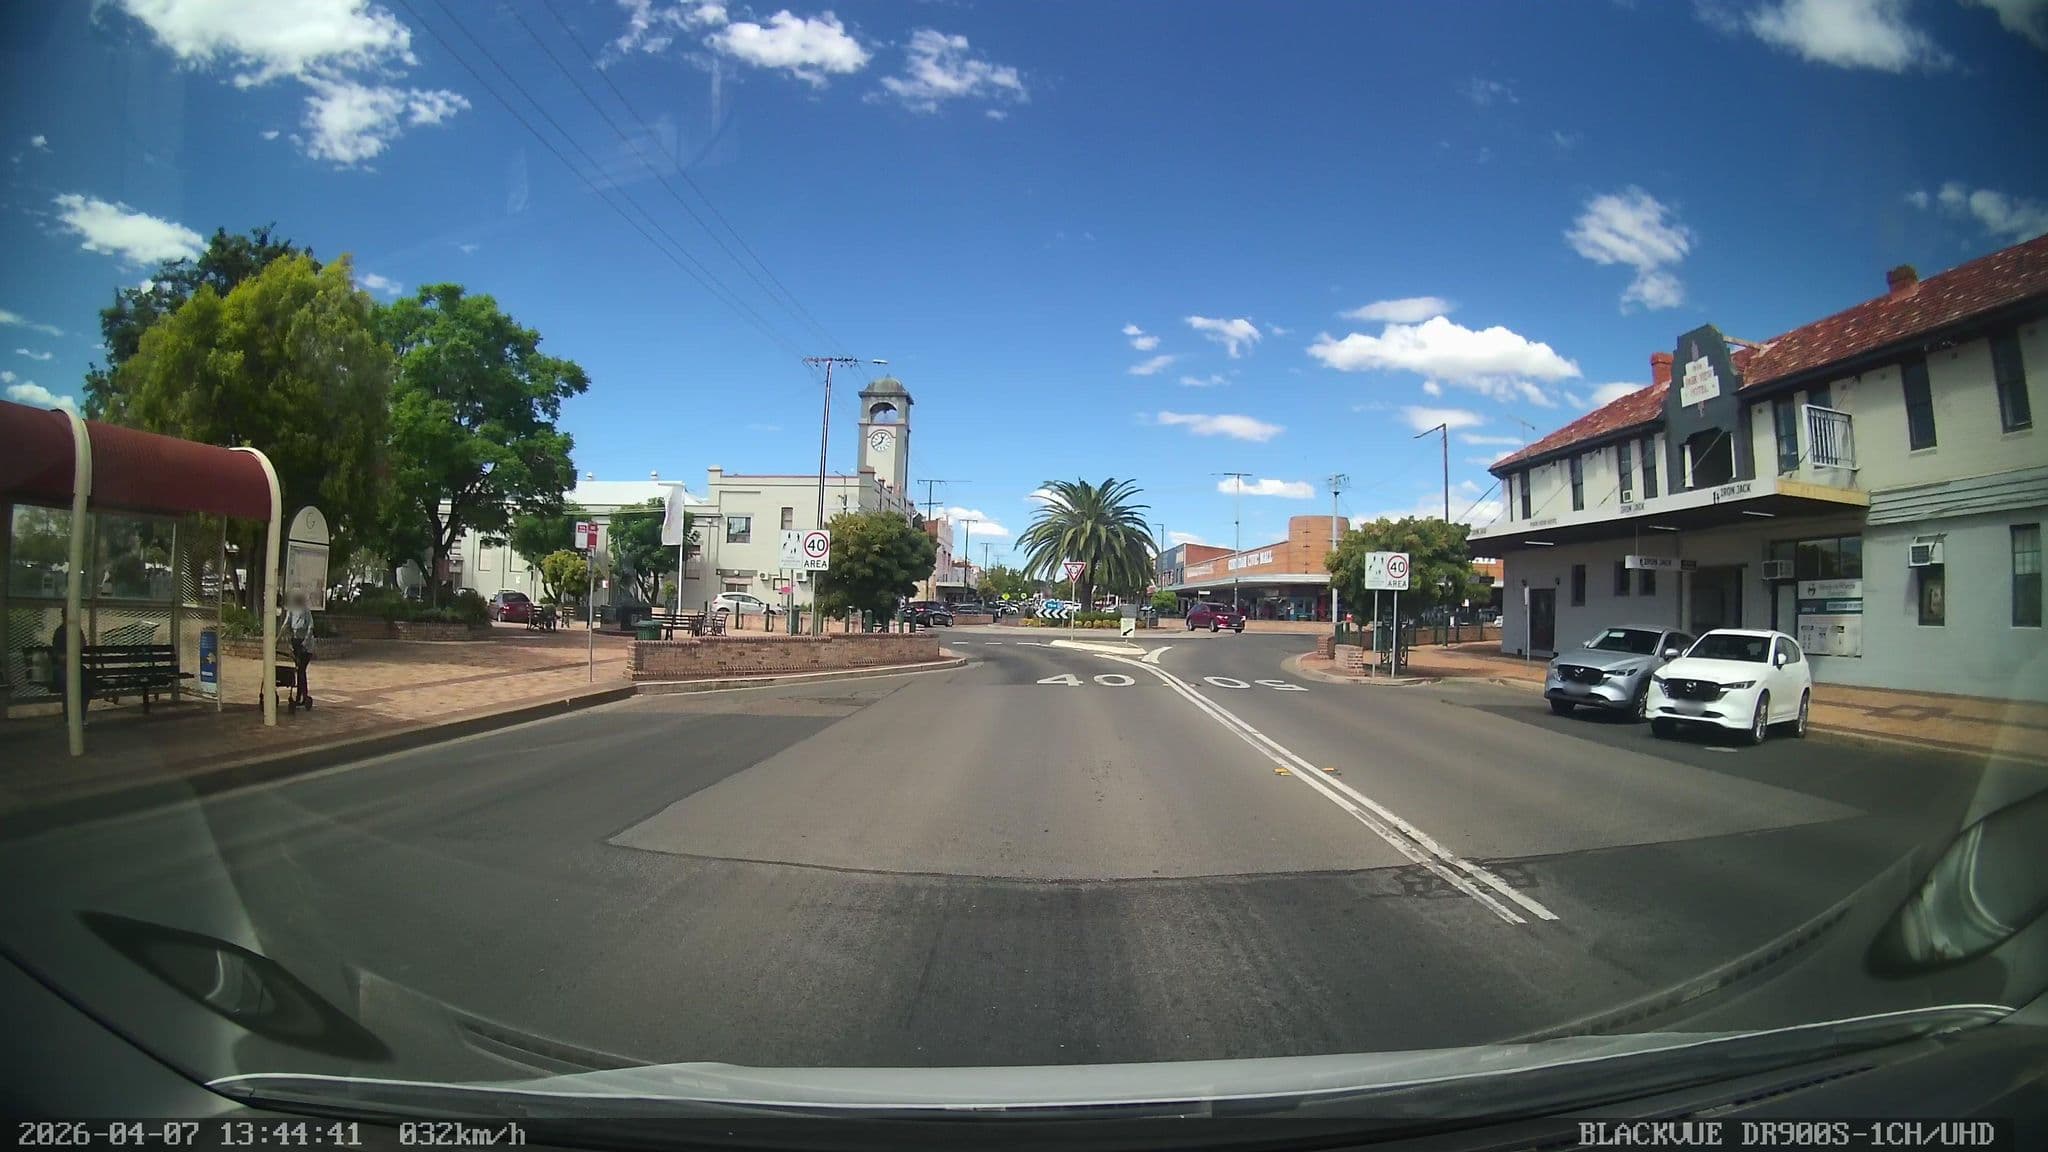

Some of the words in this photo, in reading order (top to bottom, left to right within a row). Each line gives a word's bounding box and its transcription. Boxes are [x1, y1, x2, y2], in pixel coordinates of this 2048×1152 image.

[1720, 487, 1736, 498] IRON
[1736, 484, 1752, 495] JACK
[808, 539, 826, 551] 40
[804, 559, 828, 568] AREA
[1390, 562, 1406, 573] 40
[1388, 580, 1407, 588] AREA
[1037, 673, 1136, 687] 40
